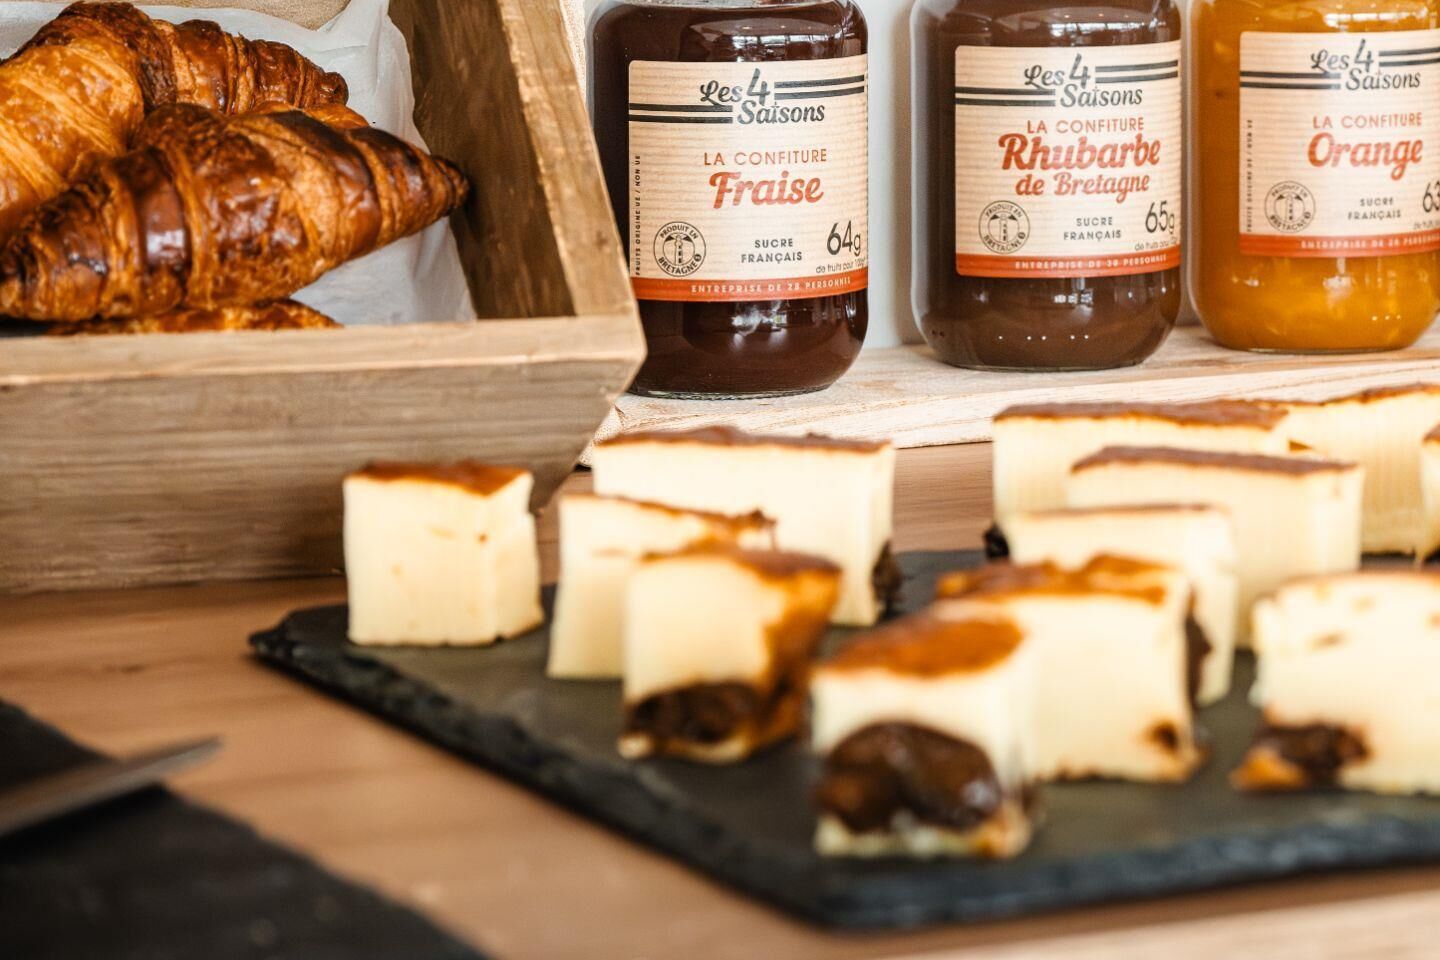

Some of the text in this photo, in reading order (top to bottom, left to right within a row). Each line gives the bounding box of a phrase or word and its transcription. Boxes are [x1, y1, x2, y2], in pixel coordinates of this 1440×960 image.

[1310, 38, 1375, 74] Les 4
[1024, 53, 1092, 91] Les 4
[1345, 68, 1422, 91] Saisons
[699, 67, 772, 107] Les 4
[1060, 83, 1144, 108] Saisons
[736, 100, 826, 125] Saisons
[1312, 111, 1424, 130] LA CONFITURE
[1026, 116, 1145, 135] LA CONFITURE
[704, 147, 828, 167] LA CONFITURE
[998, 132, 1162, 171] Rhubarbe
[1307, 132, 1424, 181] Orange
[708, 170, 825, 210] Fraise
[1014, 171, 1151, 205] de Bretagne
[1359, 197, 1395, 207] SUCRE
[1076, 216, 1113, 228] SUCRE
[1145, 200, 1175, 236] 65g
[1347, 209, 1402, 222] FRANÇAIS
[659, 224, 689, 240] PRODUIT
[826, 220, 861, 257] 64g
[1063, 229, 1122, 243] FRANÇAIS
[754, 237, 794, 249] SUCRE
[657, 255, 698, 276] BRETAGNE
[740, 250, 803, 265] FRANÇAIS
[815, 264, 826, 274] de
[827, 261, 842, 273] fruits
[1015, 260, 1084, 271] ENTREPRISE
[1087, 259, 1101, 270] DE
[691, 284, 762, 294] ENTREPRISE
[767, 283, 782, 293] DE
